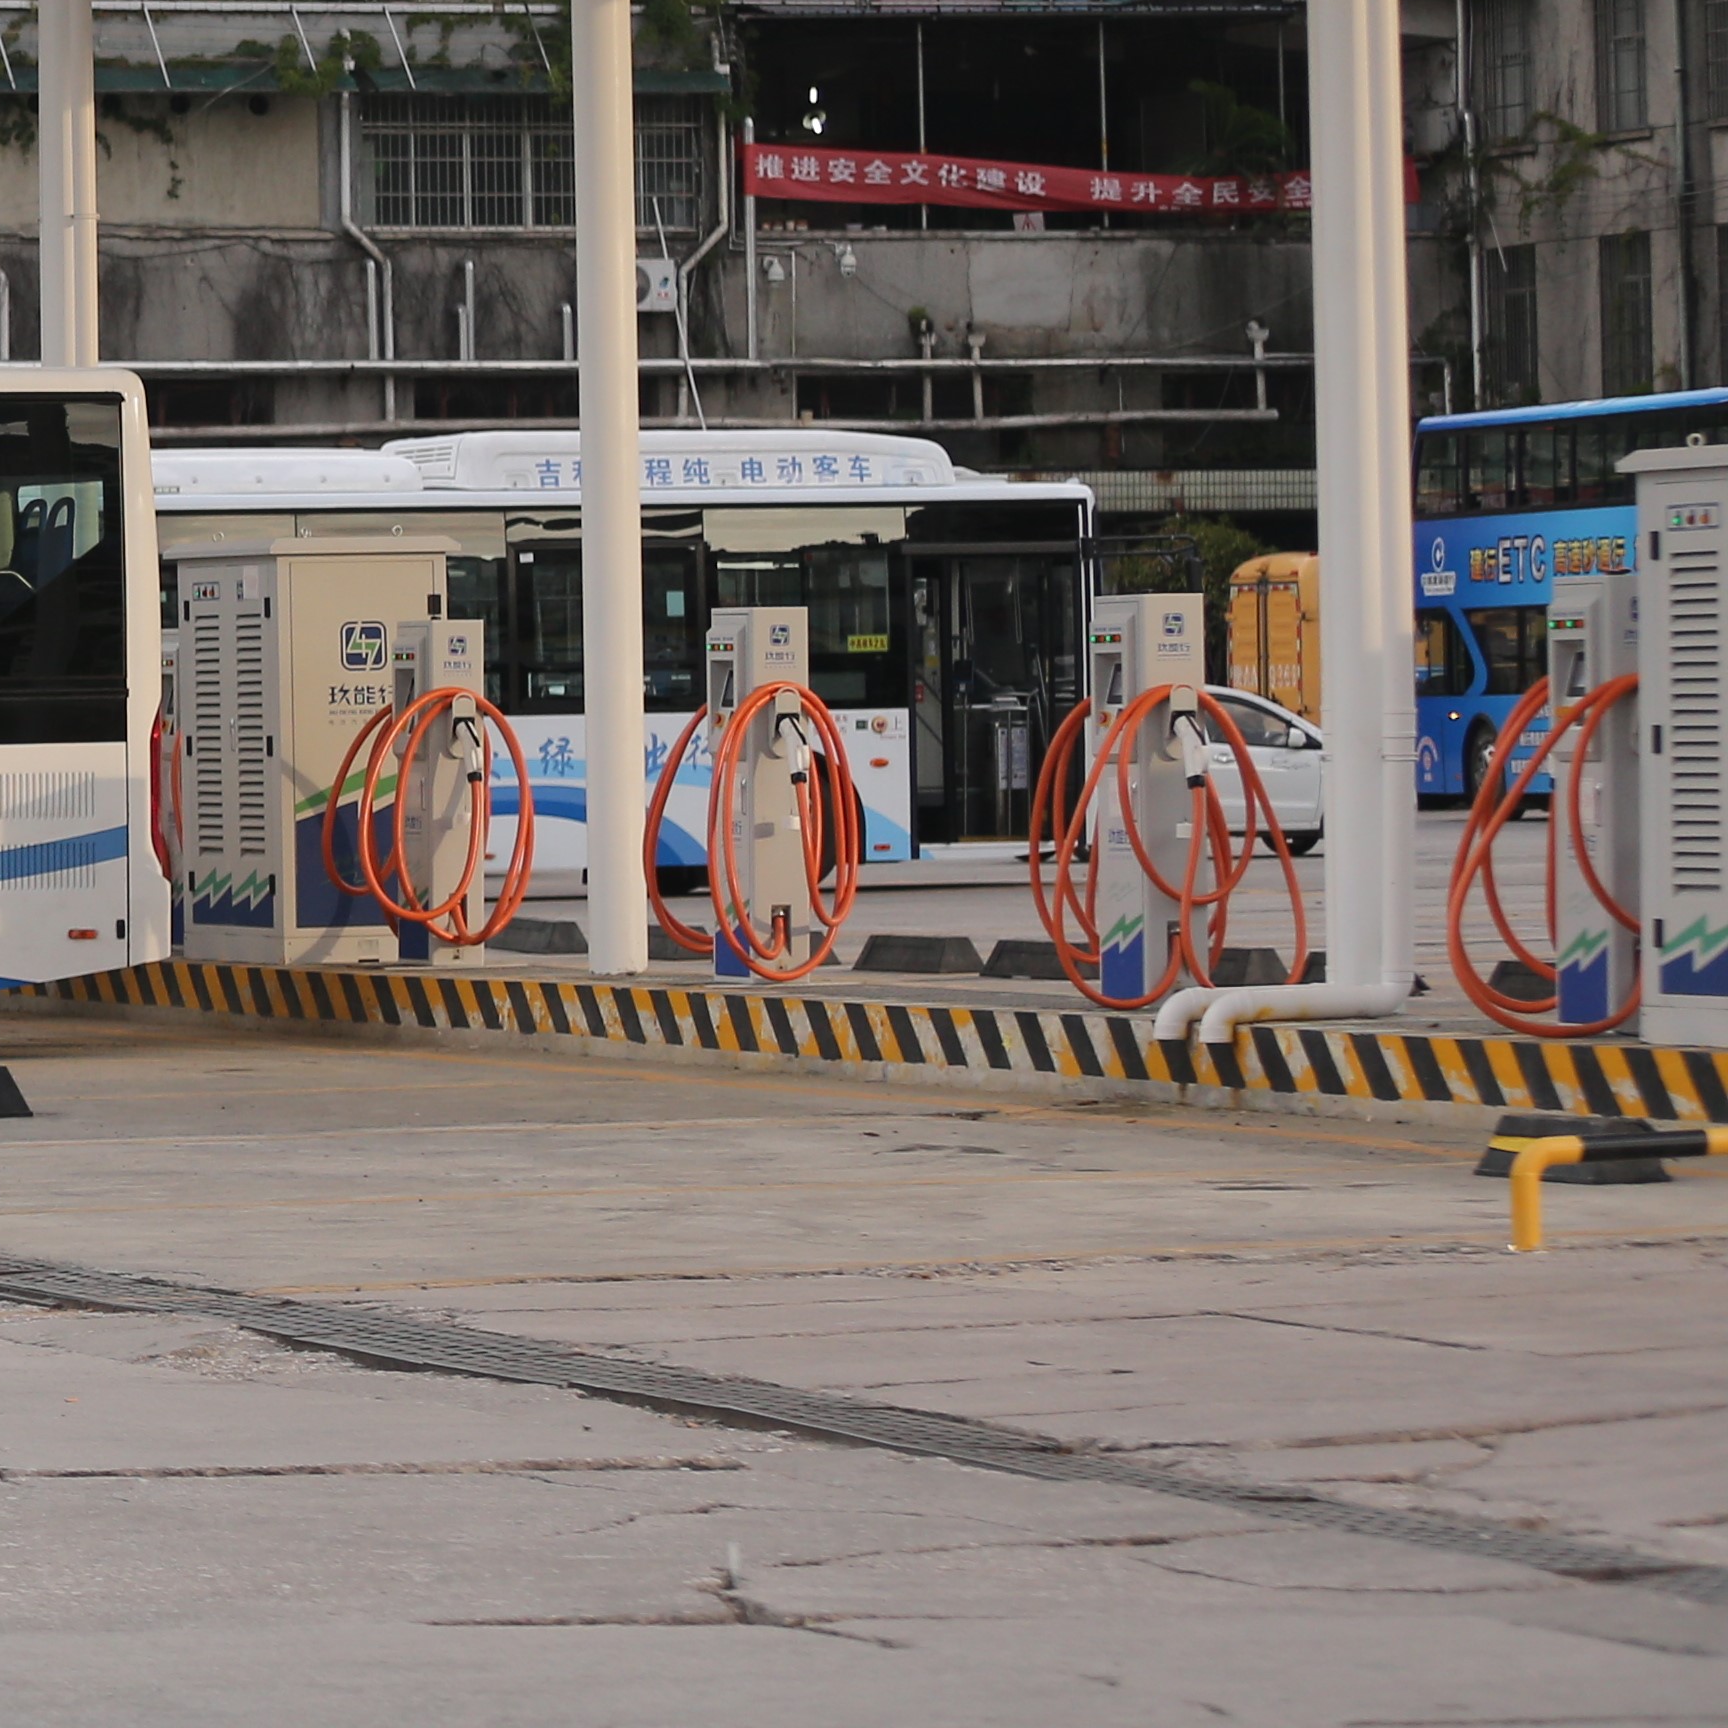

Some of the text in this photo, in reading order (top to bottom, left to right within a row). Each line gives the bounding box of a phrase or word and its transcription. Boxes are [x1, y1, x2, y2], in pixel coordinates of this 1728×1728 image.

[755, 153, 1047, 197] 推进安全文化建设
[535, 454, 873, 488] 吉程纯 电动客车
[1498, 535, 1546, 584] ETC
